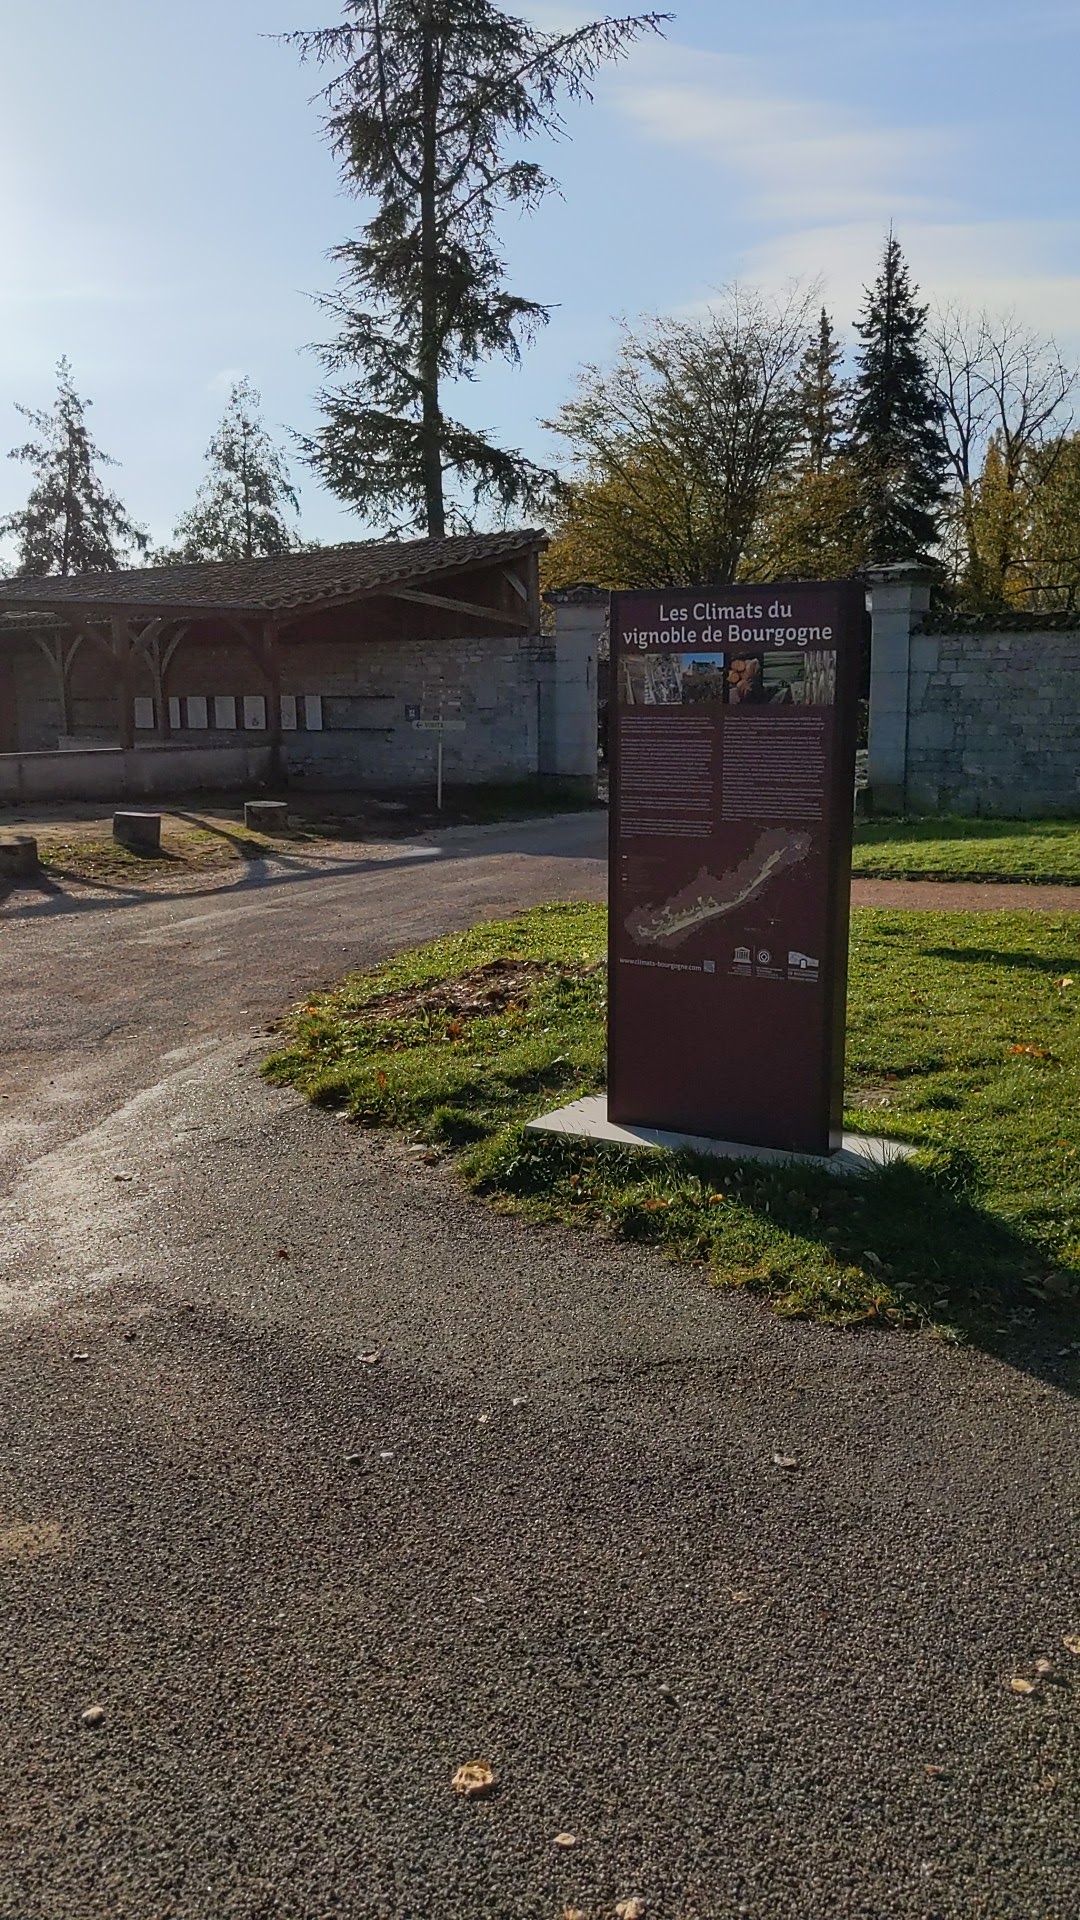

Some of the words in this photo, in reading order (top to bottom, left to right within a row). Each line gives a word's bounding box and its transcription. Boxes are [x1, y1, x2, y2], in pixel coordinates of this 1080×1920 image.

[659, 604, 688, 622] Les
[693, 602, 763, 621] Climats
[768, 600, 792, 619] du
[622, 627, 697, 649] vignoble
[701, 625, 723, 643] de
[728, 624, 833, 646] Bourgogne
[619, 957, 702, 972] www.climats-bourgogne.com
